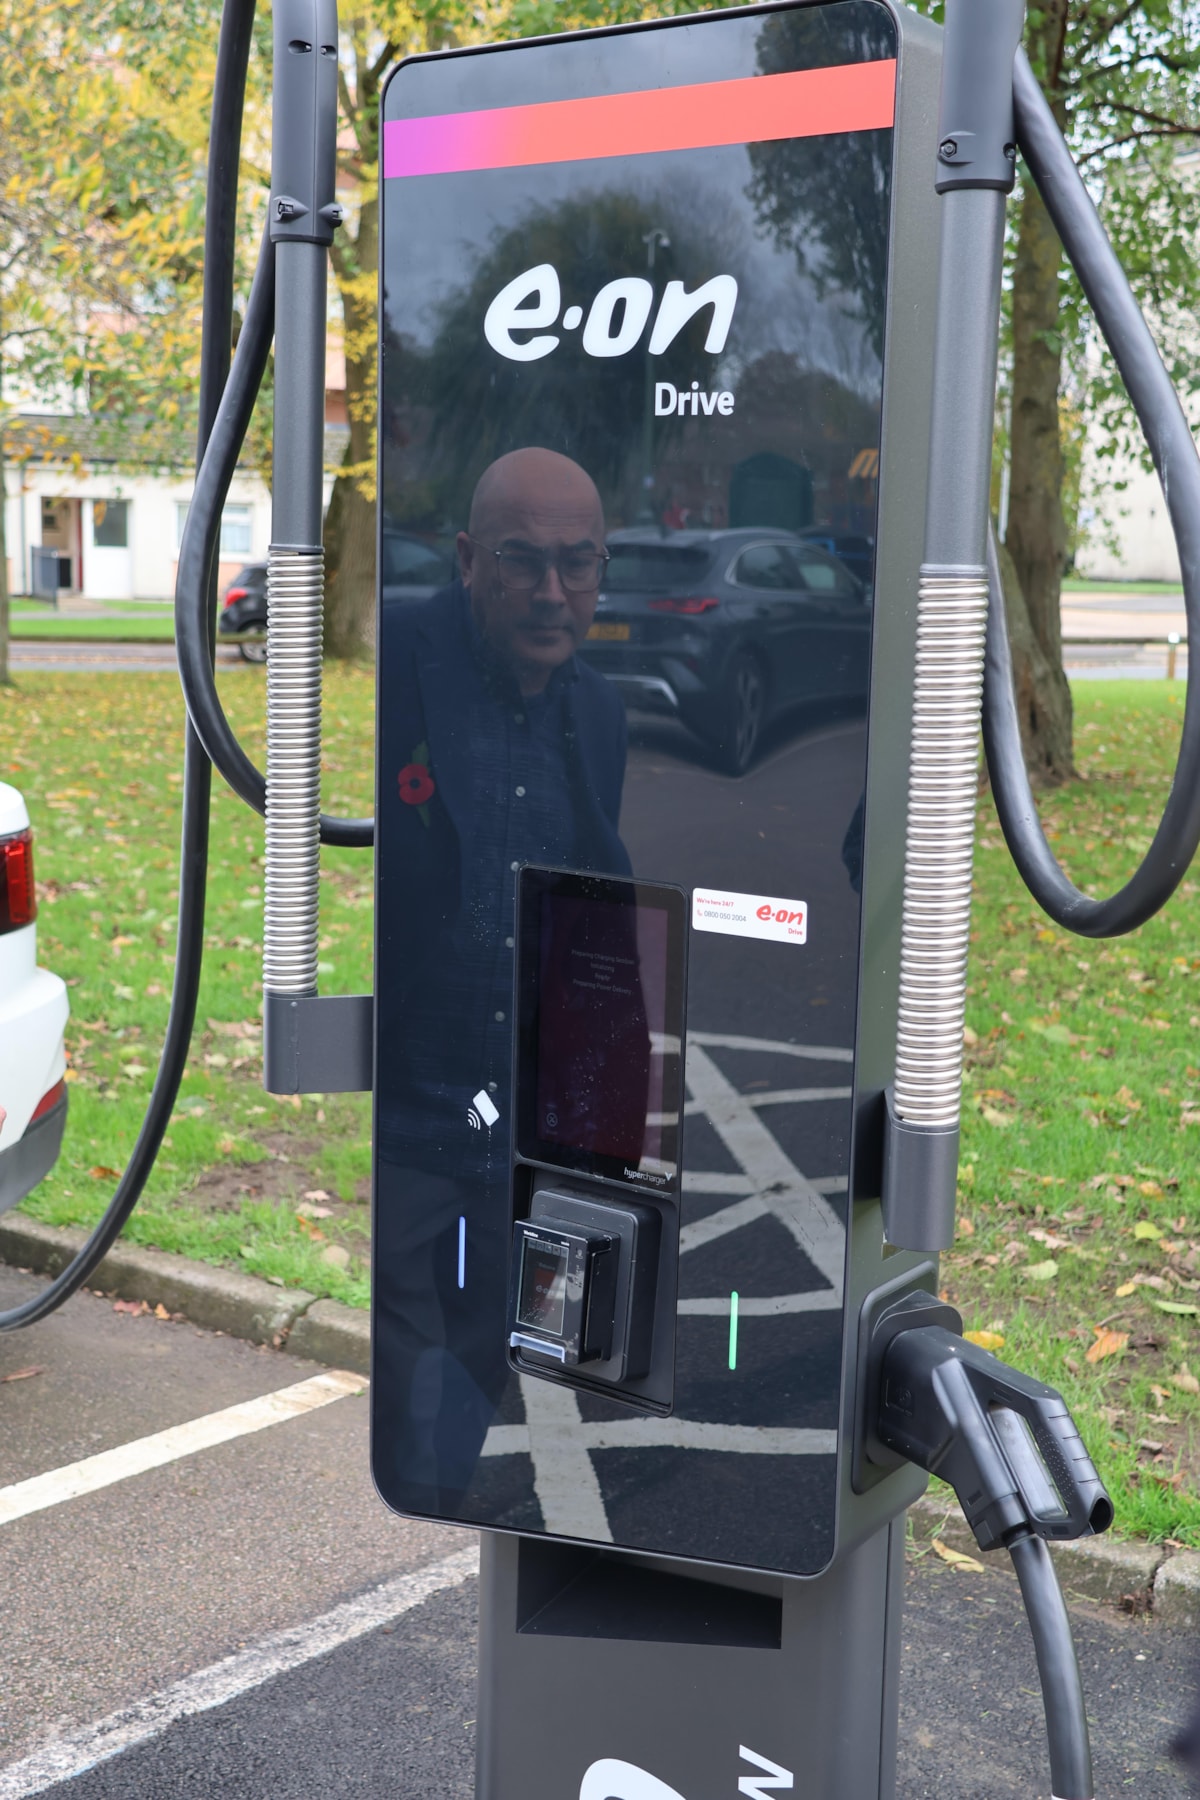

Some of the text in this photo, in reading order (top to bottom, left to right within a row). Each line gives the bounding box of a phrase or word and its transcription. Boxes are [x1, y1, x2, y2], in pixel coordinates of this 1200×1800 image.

[655, 381, 734, 416] Drive
[703, 910, 746, 922] 0800 050 2004
[788, 927, 803, 936] Drive
[624, 1167, 666, 1185] hypercharger
